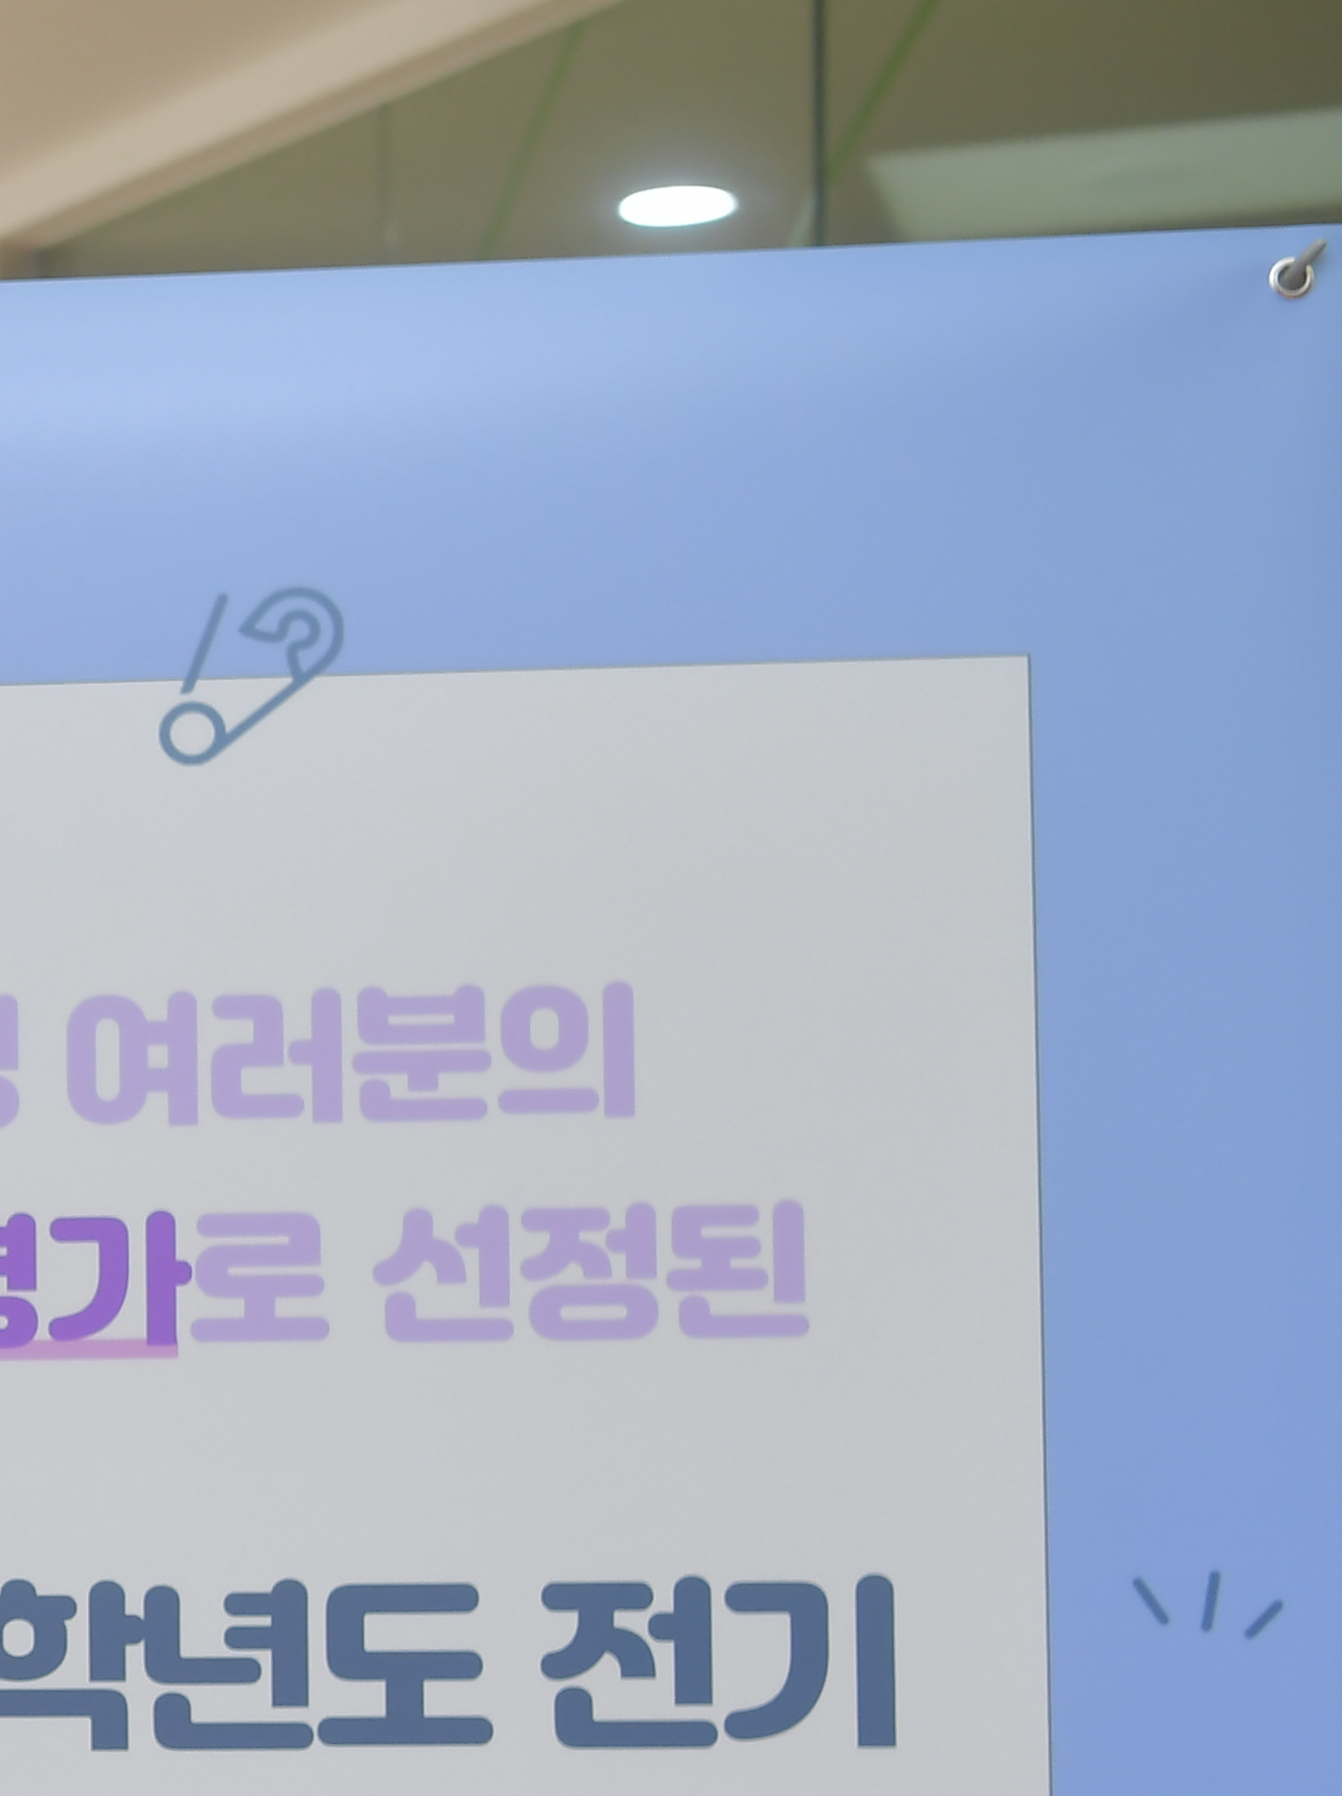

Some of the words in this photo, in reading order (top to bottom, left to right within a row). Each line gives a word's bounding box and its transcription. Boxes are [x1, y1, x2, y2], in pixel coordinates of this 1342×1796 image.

[66, 980, 636, 1127] 여러분의
[373, 1199, 810, 1342] 선정된
[540, 1573, 900, 1752] 전기
